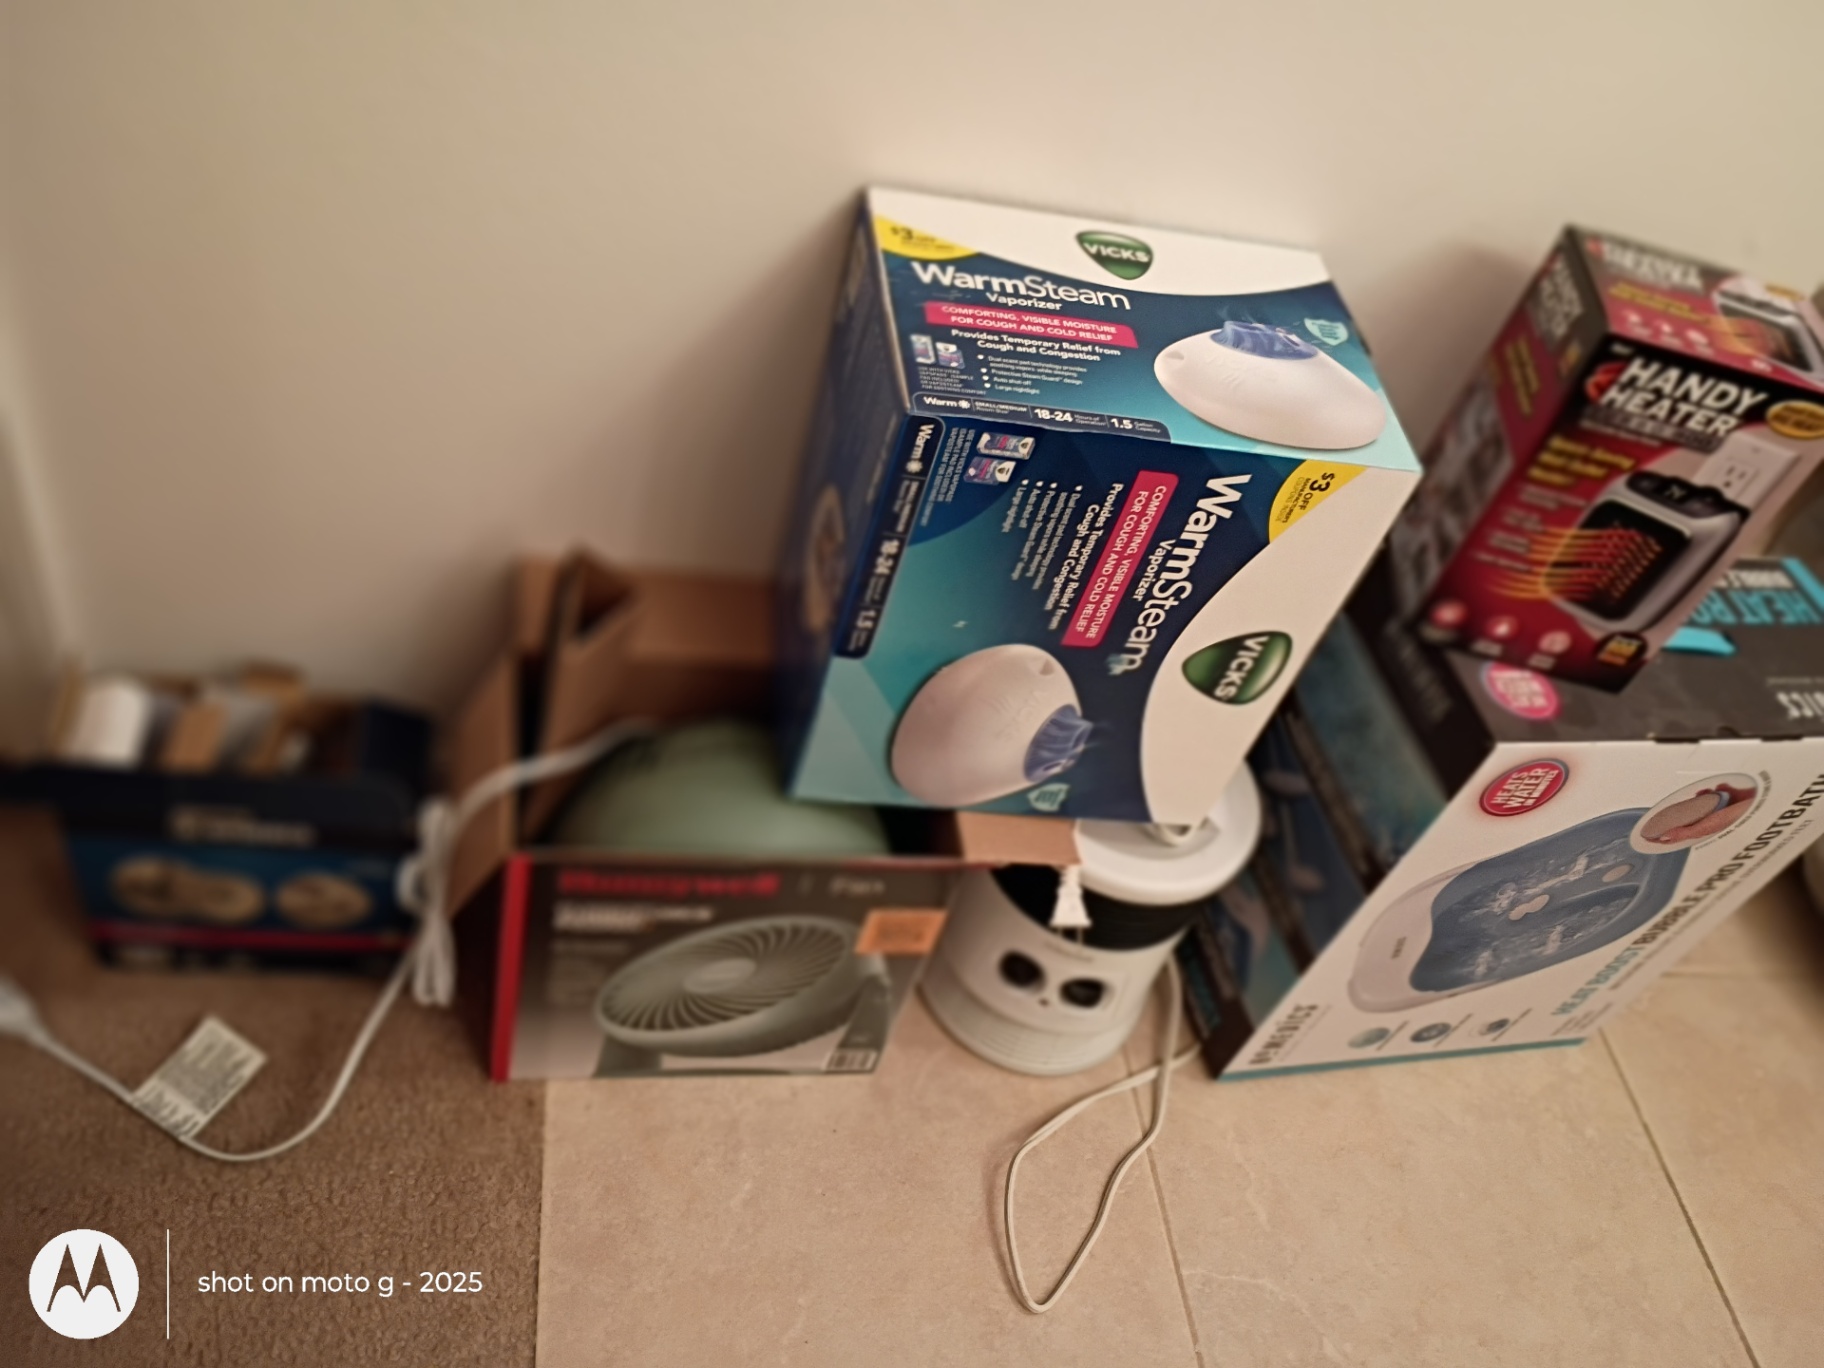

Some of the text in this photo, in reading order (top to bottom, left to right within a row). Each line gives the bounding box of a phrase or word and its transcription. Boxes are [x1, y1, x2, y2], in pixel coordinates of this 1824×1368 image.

[1082, 242, 1150, 263] VICKS
[910, 259, 1131, 310] WarmSteam
[985, 291, 1064, 313] Vaporizer
[940, 304, 1117, 333] COMFORTING, VISIBLE MOISTURE
[950, 314, 1114, 341] FOR COUGH AND COLD RELIEF
[950, 328, 1121, 356] Provides Temporary Relief from
[975, 339, 1102, 363] Cough and Congestion
[922, 395, 958, 408] Warm
[1618, 357, 1768, 416] HANDY
[1033, 408, 1074, 422] 18-24
[1109, 417, 1134, 430] 1.5
[1601, 386, 1740, 438] HEATER
[911, 423, 933, 459] Warm
[1298, 472, 1335, 510] $3 OFF
[873, 538, 900, 574] 18-24
[1041, 503, 1099, 610] Cough and Congestion
[1049, 482, 1123, 630] Provides Temporary Relief from
[1075, 490, 1148, 632] FOR COUGH AND COLD RELIEF
[1086, 484, 1166, 638] COMFORTING, VISIBLE MOISTURE
[1112, 470, 1254, 672] WarmSteam
[1129, 537, 1174, 601] Vaporizer
[1213, 634, 1268, 698] VICKS
[1490, 771, 1529, 804] HEATS
[1502, 767, 1551, 808] WATER
[1585, 947, 1646, 986] BOOST
[1631, 890, 1709, 945] BUBBLE
[1693, 862, 1745, 892] PRO
